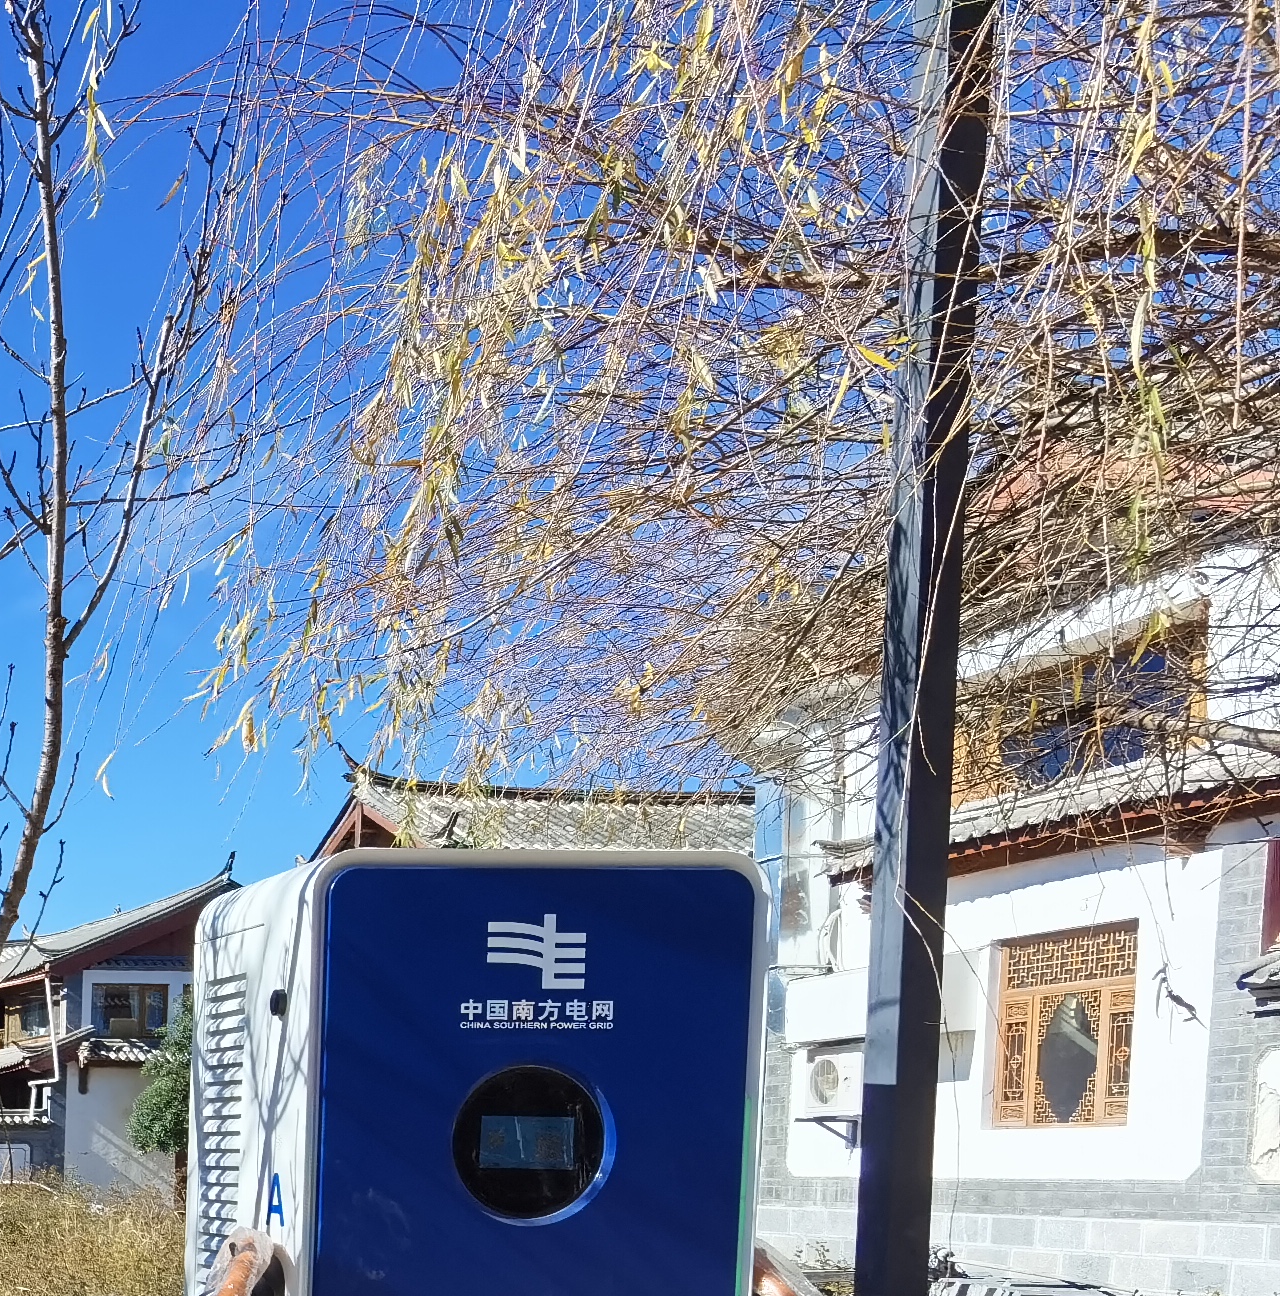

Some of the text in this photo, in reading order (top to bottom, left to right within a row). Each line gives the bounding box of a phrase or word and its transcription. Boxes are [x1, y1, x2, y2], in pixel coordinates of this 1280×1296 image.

[460, 999, 614, 1021] 中国南方电网
[460, 1021, 614, 1030] CHINA SOUTHERN POWER GRID
[266, 1172, 285, 1227] A
